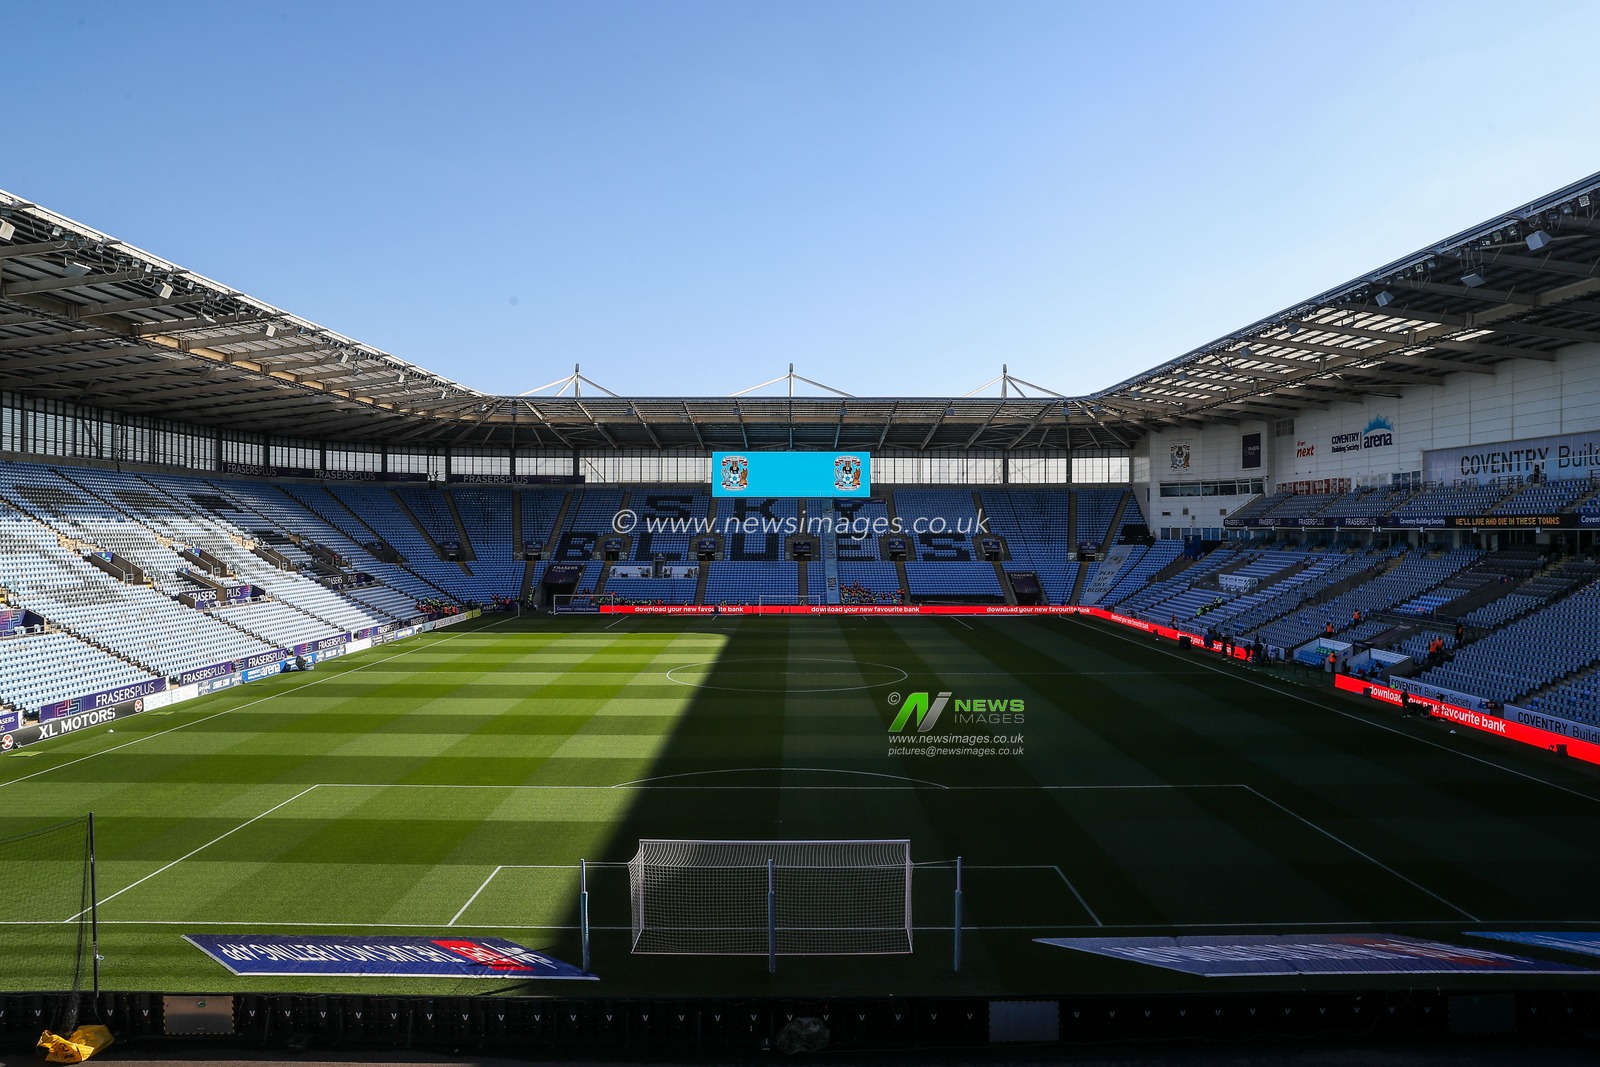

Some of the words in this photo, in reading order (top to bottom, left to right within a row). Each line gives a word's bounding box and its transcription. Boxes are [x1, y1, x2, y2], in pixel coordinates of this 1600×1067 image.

[1331, 432, 1360, 444] COVENTRY
[1364, 432, 1393, 448] arena
[1460, 447, 1550, 476] COVENTRY
[227, 464, 278, 477] FRASERSPLUS
[314, 470, 376, 480] FRASERSPLUS
[463, 474, 528, 484] FRASERSPLUS
[1472, 517, 1484, 526] LIVE
[1516, 517, 1538, 526] THESE
[1538, 517, 1560, 526] TOWNS
[226, 588, 241, 598] PLUS
[318, 635, 347, 650] FRASERSPLUS
[248, 650, 285, 668] FRASERSPLUS
[182, 665, 226, 684] FRASERSPLUS
[260, 663, 280, 676] arena
[95, 682, 155, 707] FRASERSPLUS
[1449, 693, 1472, 708] Society
[38, 723, 58, 740] XL
[61, 707, 116, 733] MOTORS
[1482, 716, 1506, 733] bank
[1518, 712, 1568, 734] COVENTRY
